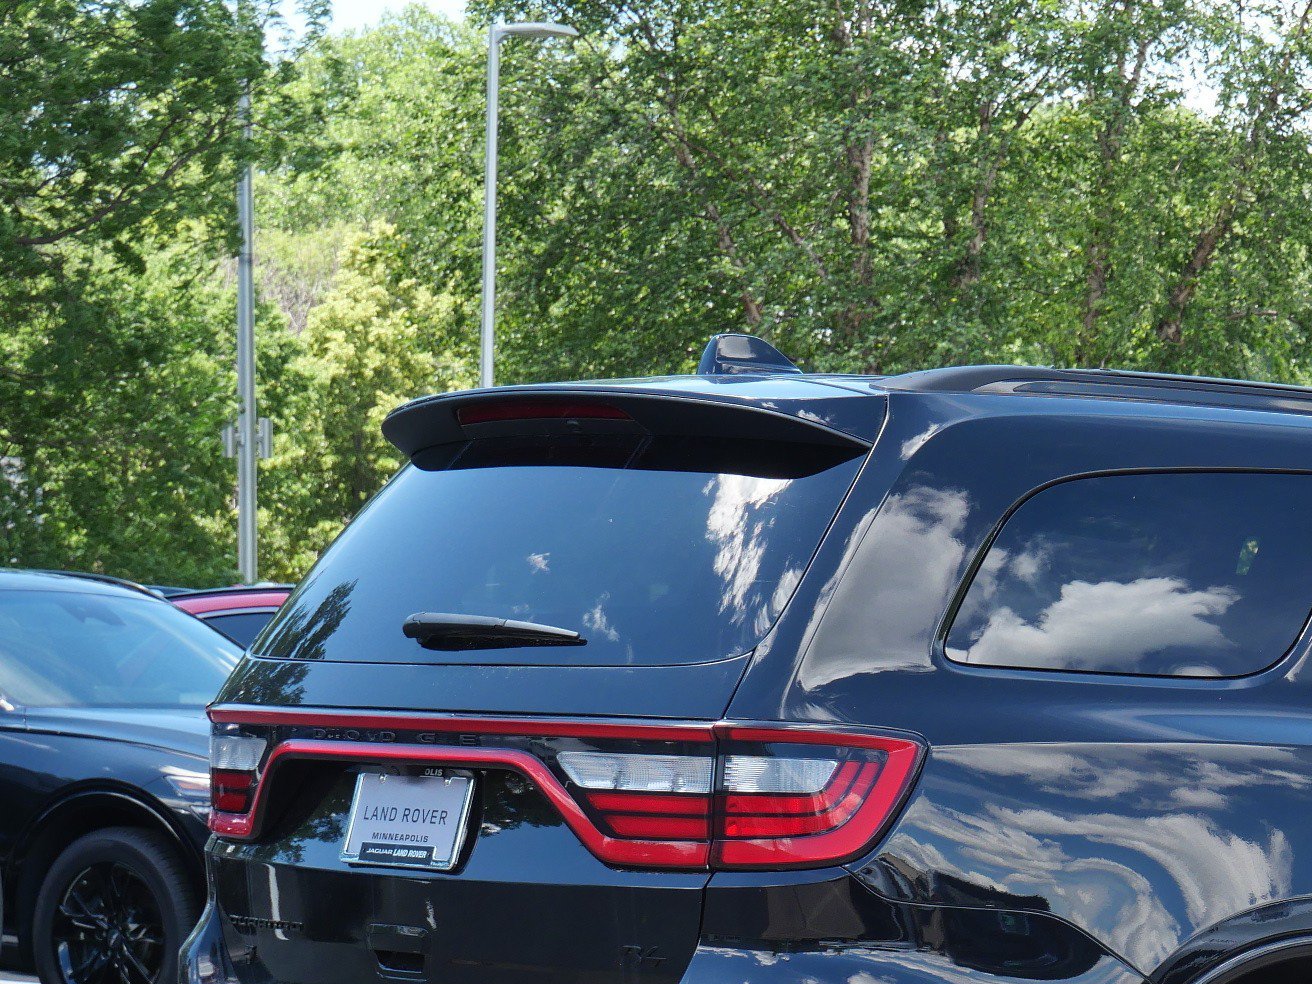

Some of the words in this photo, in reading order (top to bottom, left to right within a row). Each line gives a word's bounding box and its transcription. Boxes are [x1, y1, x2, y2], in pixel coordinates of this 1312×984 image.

[312, 728, 478, 746] DODGE
[364, 805, 398, 822] LAND
[402, 807, 448, 826] ROVER
[371, 832, 429, 843] MINNEAPOLIS
[366, 847, 393, 855] JAGUAR
[393, 848, 407, 857] LAND
[407, 850, 427, 858] ROVER
